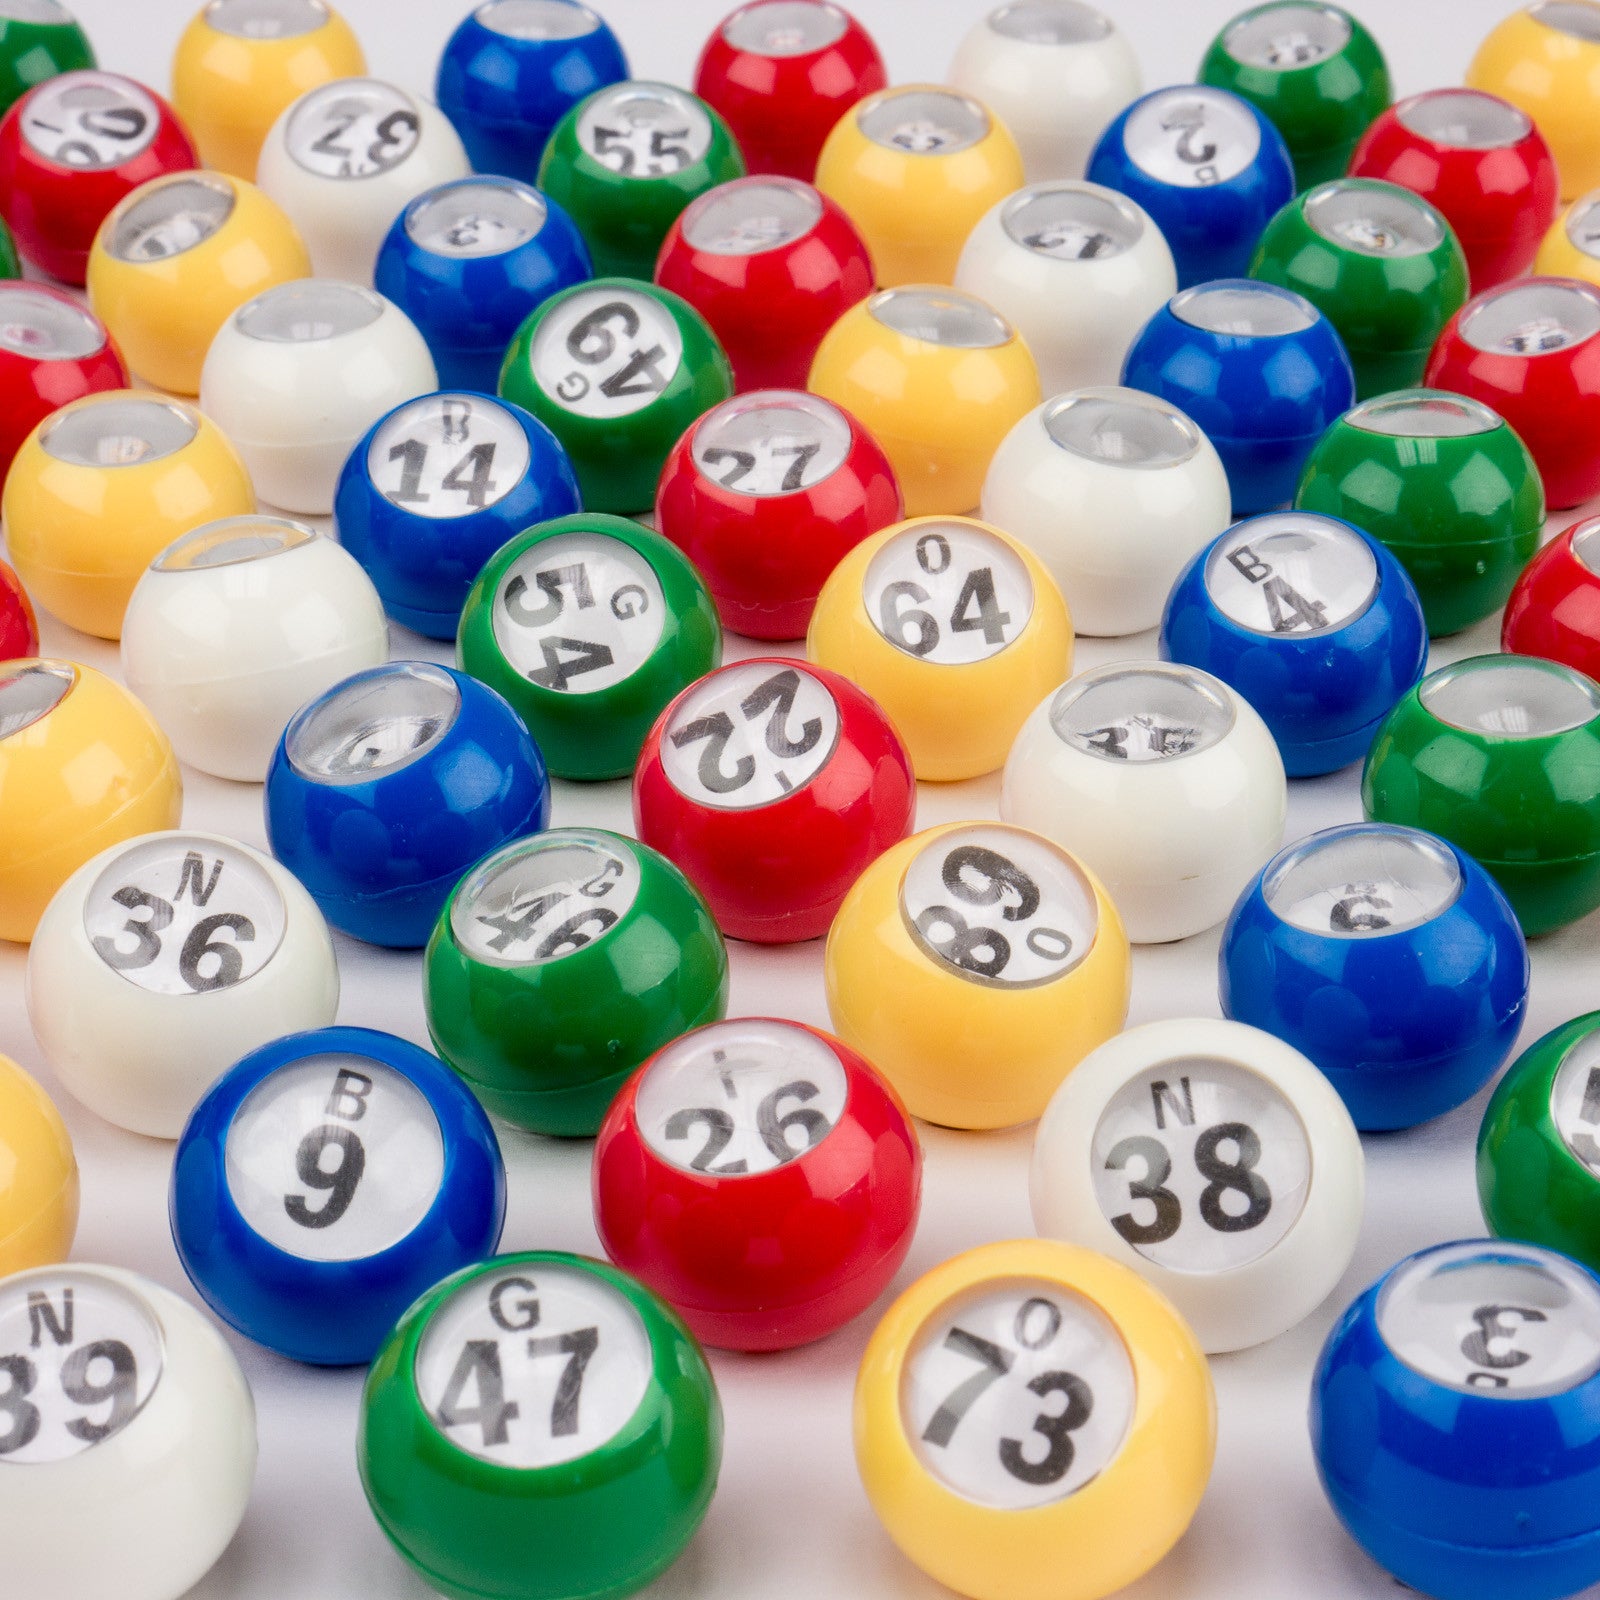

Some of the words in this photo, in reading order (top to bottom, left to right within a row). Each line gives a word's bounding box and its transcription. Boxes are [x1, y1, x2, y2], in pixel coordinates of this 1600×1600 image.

[594, 126, 691, 174] 55
[567, 302, 671, 400] 49
[556, 371, 590, 402] G
[442, 400, 472, 445] B
[387, 438, 497, 507] 14
[702, 442, 820, 491] 27
[1226, 545, 1273, 584] B
[503, 562, 614, 691] 54
[610, 584, 649, 620] G
[878, 567, 1011, 655] 64
[1262, 575, 1329, 632] 4
[669, 669, 822, 794] 22
[173, 851, 224, 907] N
[578, 858, 624, 898] G
[92, 886, 256, 993] 36
[475, 892, 619, 958] 46
[912, 845, 1041, 978] 68
[324, 1068, 374, 1122] B
[1150, 1076, 1197, 1130] N
[664, 1080, 832, 1175] 26
[283, 1124, 366, 1230] 9
[1104, 1122, 1273, 1245] 38
[28, 1288, 73, 1348] N
[487, 1277, 541, 1332] G
[1460, 1305, 1547, 1368] 3
[438, 1326, 599, 1446] 47
[921, 1327, 1095, 1486] 73
